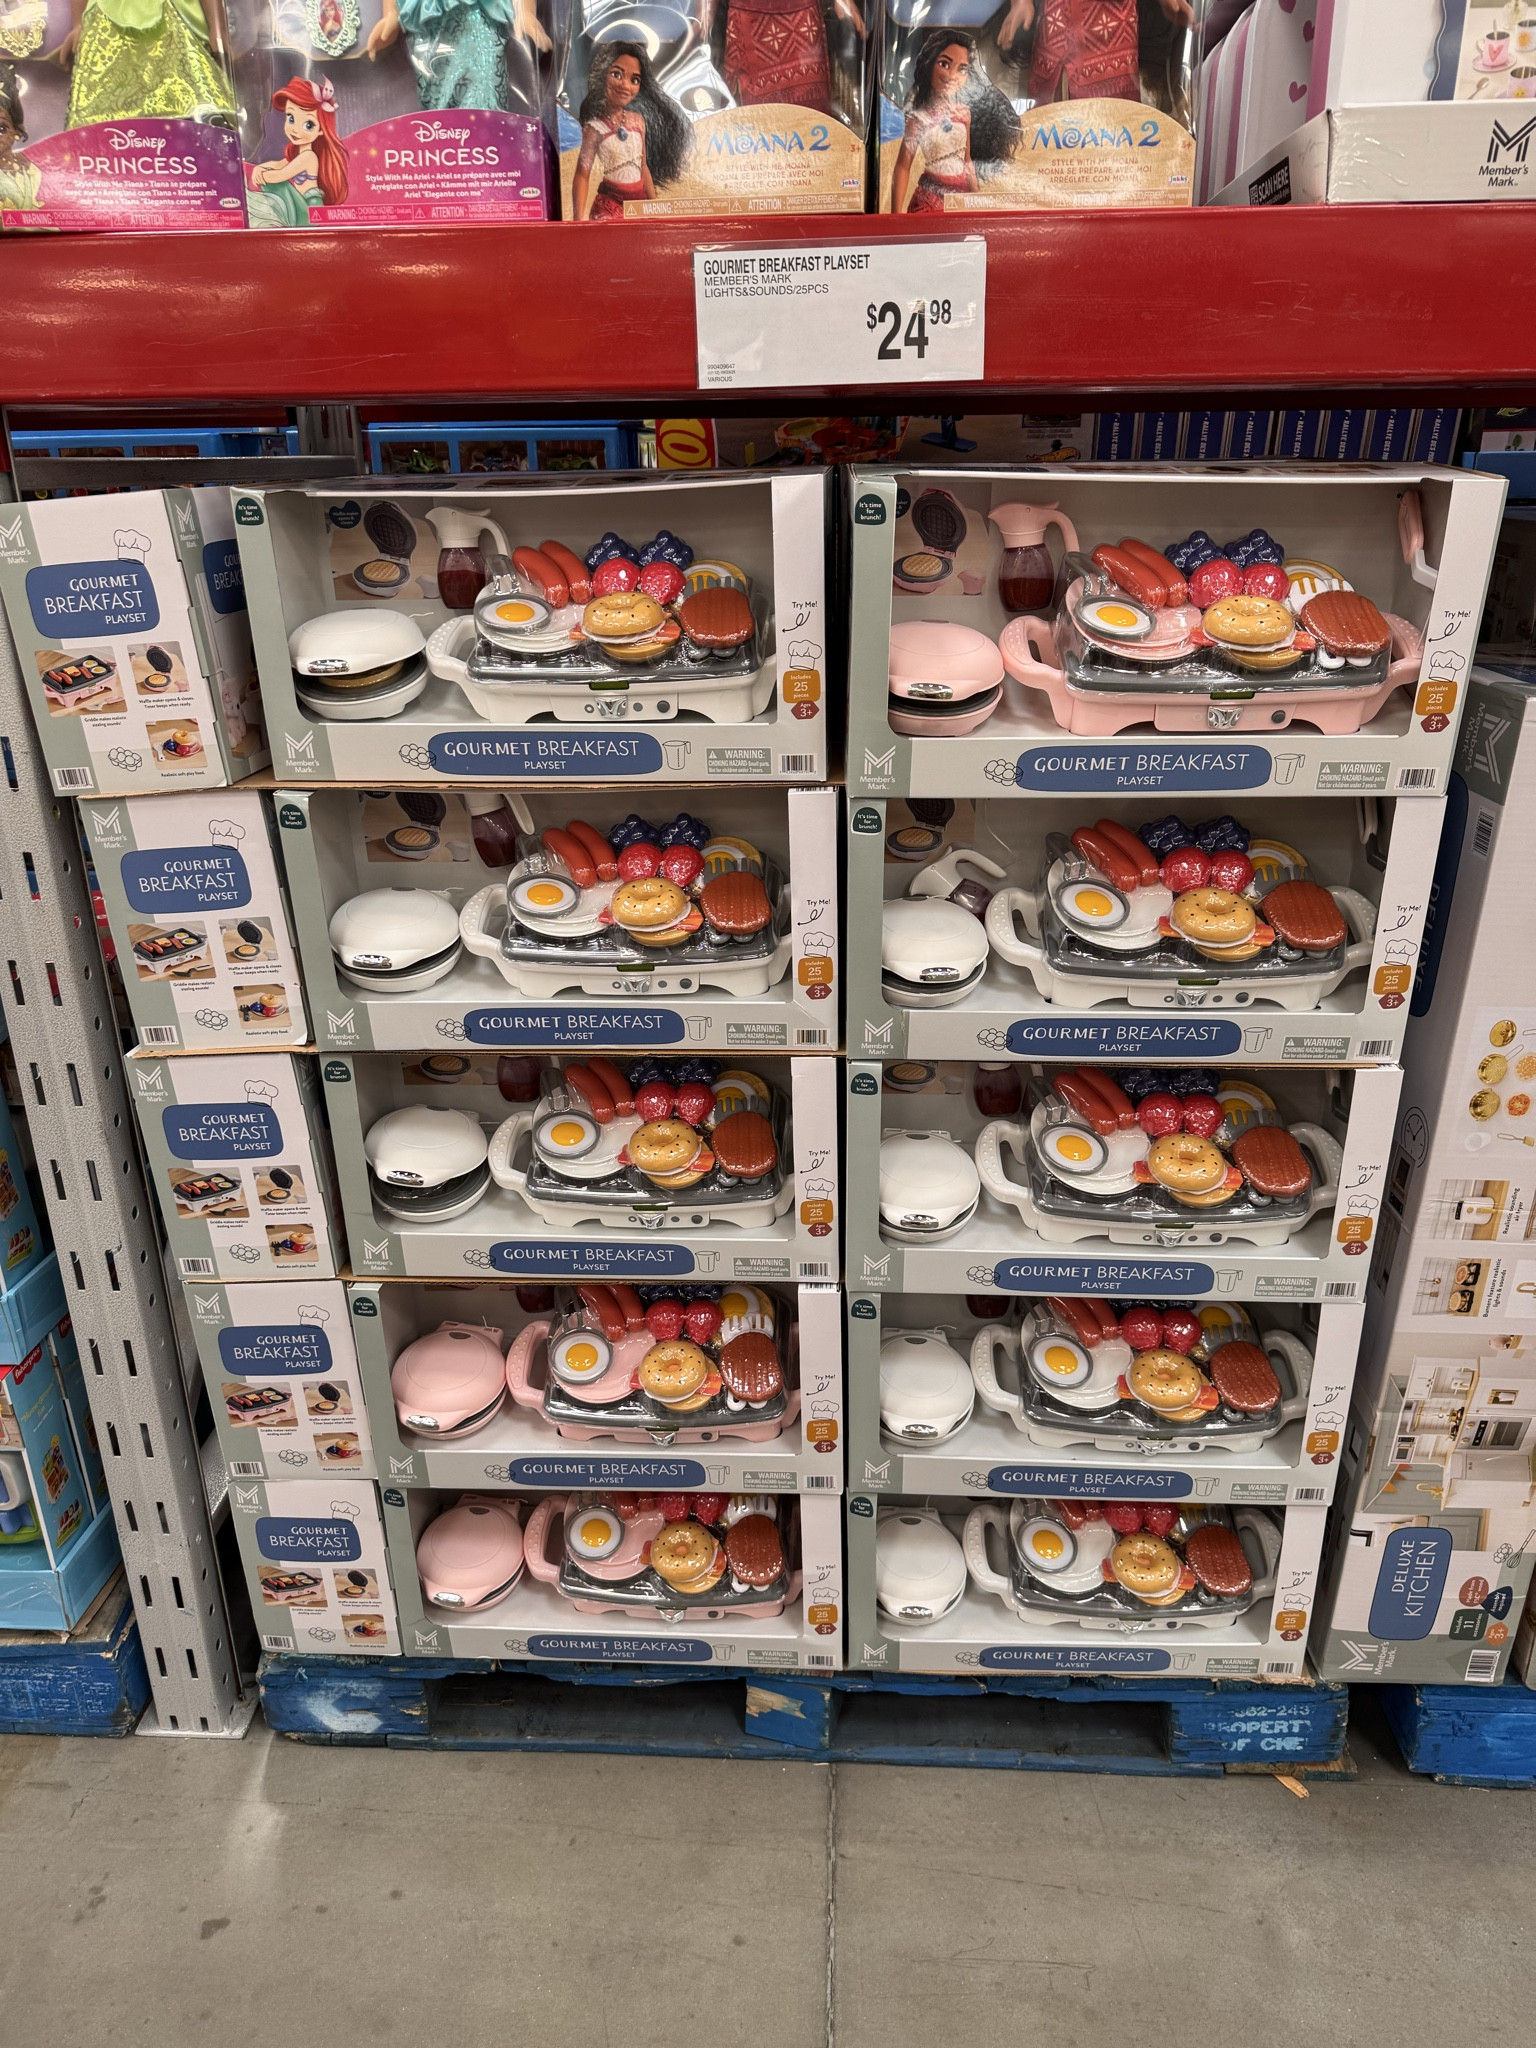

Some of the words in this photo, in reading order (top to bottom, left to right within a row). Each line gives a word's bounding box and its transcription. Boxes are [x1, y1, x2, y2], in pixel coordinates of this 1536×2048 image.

[411, 120, 470, 146] Disney
[526, 124, 537, 132] 3+
[104, 129, 166, 155] Disney
[705, 130, 805, 156] MOANA
[809, 125, 831, 152] 2
[1032, 124, 1133, 150] MOANA
[1138, 121, 1161, 147] 2
[385, 147, 499, 168] PRINCESS
[80, 156, 197, 174] PRINCESS
[1479, 165, 1528, 176] Member's
[462, 172, 488, 180] prépare
[1488, 176, 1513, 187] Mark
[1258, 177, 1274, 201] SCAN
[1273, 166, 1289, 191] HERE
[328, 209, 356, 219] WARNING:
[432, 207, 464, 218] ATTENTION
[643, 203, 673, 214] WARNING:
[748, 200, 782, 211] ATTENTION
[704, 259, 756, 275] GOURMET
[759, 256, 821, 272] BREAKFAST
[824, 254, 870, 270] PLAYSET
[704, 275, 758, 286] MEMBER'S
[762, 274, 791, 284] MARK
[704, 284, 829, 298] LIGHTS&SOUNDS/25PCS
[70, 574, 138, 592] GOURMET
[45, 590, 143, 614] BREAKFAST
[105, 613, 146, 624] PLAYSET
[1444, 611, 1455, 619] Try
[1457, 610, 1471, 618] Me!
[794, 682, 807, 691] 25
[1428, 693, 1443, 703] 25
[800, 708, 812, 717] 3+
[1429, 720, 1442, 730] 3+
[444, 742, 530, 757] GOURMET
[538, 740, 639, 755] BREAKFAST
[725, 750, 765, 759] WARNING:
[524, 761, 565, 769] PLAYSET
[1034, 757, 1130, 772] GOURMET
[1136, 754, 1249, 771] BREAKFAST
[1340, 764, 1384, 774] WARNING:
[1117, 776, 1163, 785] PLAYSET
[164, 858, 232, 872] GOURMET
[139, 872, 235, 892] BREAKFAST
[198, 892, 238, 901] PLAYSET
[808, 967, 821, 976] 25
[1385, 976, 1398, 984] 25
[1387, 999, 1398, 1007] 3+
[479, 1016, 561, 1030] GOURMET
[568, 1015, 663, 1028] BREAKFAST
[744, 1024, 782, 1033] WARNING:
[1023, 1027, 1110, 1040] GOURMET
[1117, 1026, 1221, 1040] BREAKFAST
[1304, 1038, 1344, 1047] WARNING:
[202, 1113, 265, 1126] GOURMET
[179, 1126, 268, 1142] BREAKFAST
[233, 1142, 271, 1151] PLAYSET
[1503, 1212, 1513, 1234] Realistic
[1509, 1187, 1520, 1211] sounding
[1515, 1201, 1524, 1214] fryer
[504, 1248, 579, 1260] GOURMET
[586, 1249, 674, 1262] BREAKFAST
[1009, 1265, 1092, 1278] GOURMET
[1097, 1266, 1194, 1280] BREAKFAST
[257, 1335, 316, 1345] GOURMET
[234, 1346, 319, 1359] BREAKFAST
[523, 1464, 596, 1474] GOURMET
[602, 1464, 686, 1476] BREAKFAST
[1002, 1472, 1079, 1484] GOURMET
[1084, 1474, 1175, 1487] BREAKFAST
[291, 1527, 347, 1535] GOURMET
[270, 1537, 349, 1547] BREAKFAST
[1392, 1540, 1415, 1592] DELUXE
[1404, 1541, 1438, 1616] KITCHEN
[1454, 1616, 1463, 1633] Includes
[1473, 1614, 1482, 1637] accessories
[1495, 1628, 1504, 1639] 3+
[540, 1640, 608, 1649] GOURMET
[614, 1640, 694, 1652] BREAKFAST
[993, 1651, 1064, 1660] GOURMET
[1070, 1652, 1154, 1662] BREAKFAST
[1374, 1641, 1390, 1675] Member's
[1385, 1648, 1395, 1667] Mark
